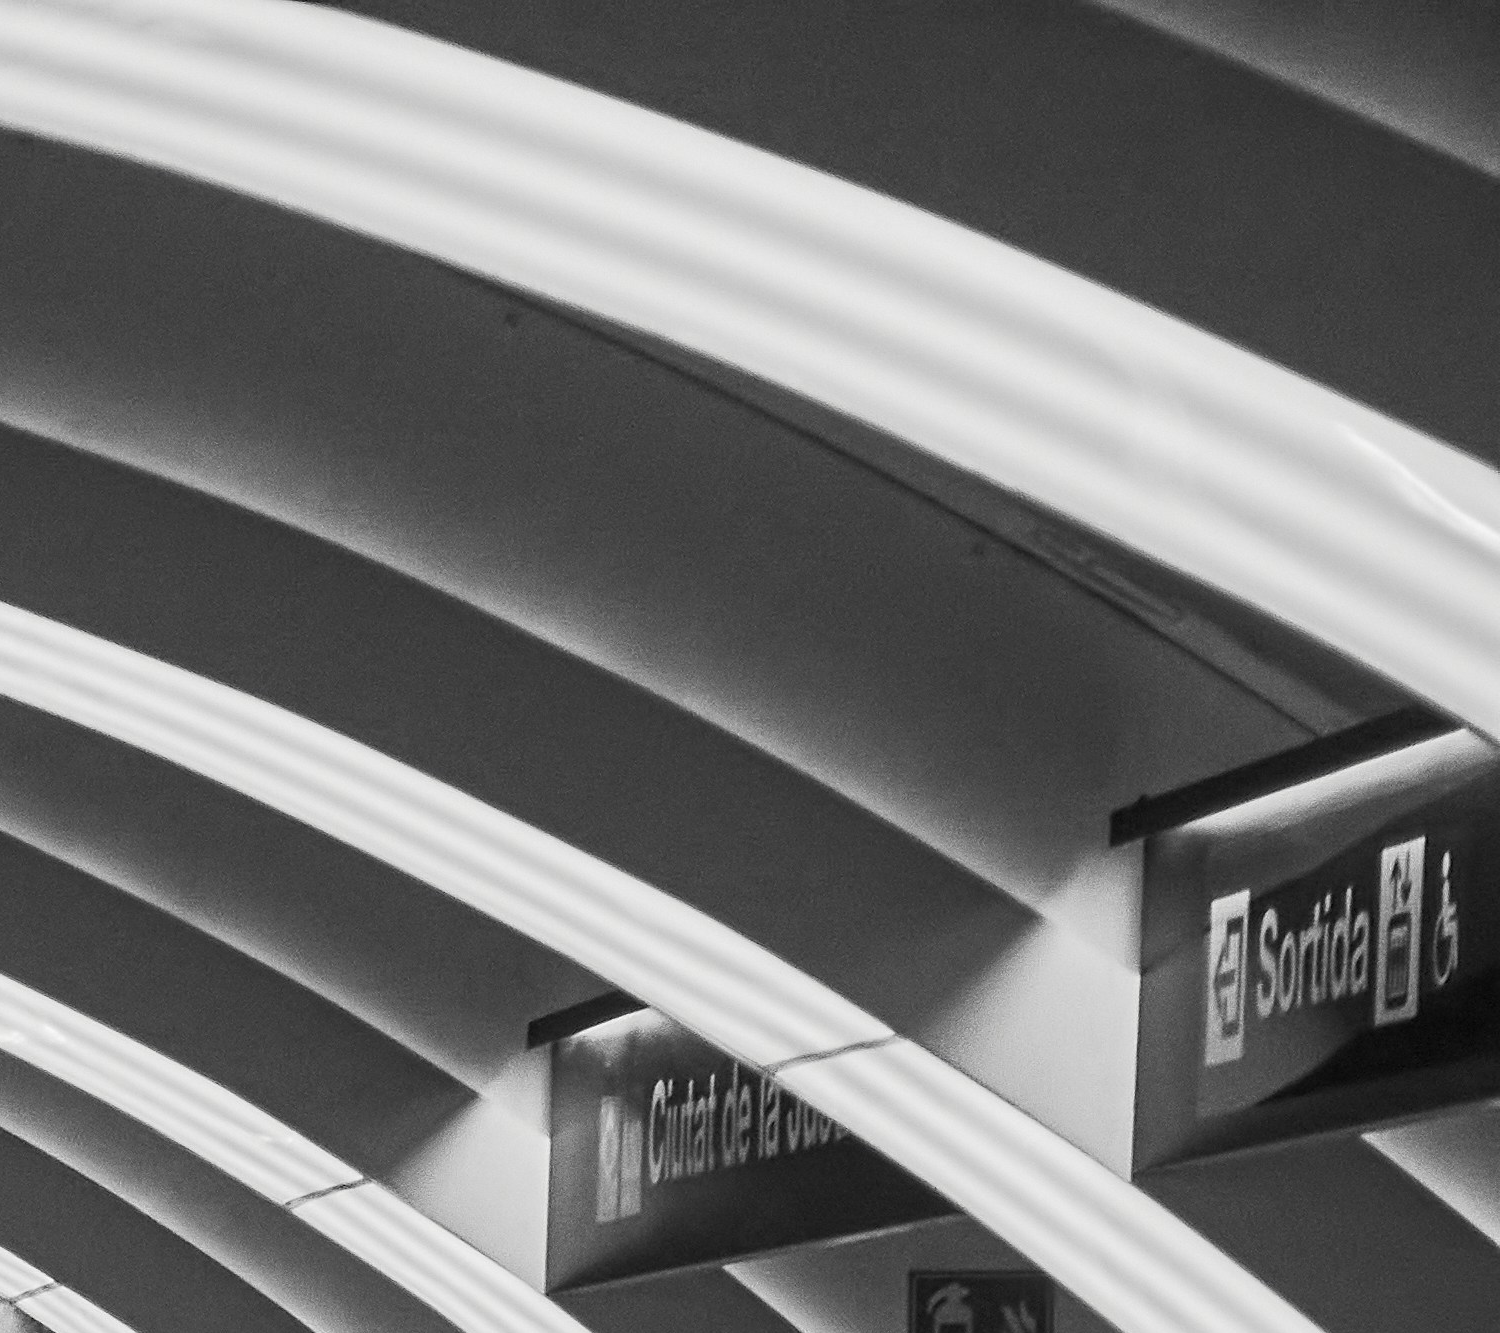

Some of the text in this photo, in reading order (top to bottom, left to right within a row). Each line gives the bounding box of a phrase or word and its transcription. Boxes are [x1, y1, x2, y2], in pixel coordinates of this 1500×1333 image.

[1256, 885, 1370, 1020] Sortida
[648, 1072, 717, 1184] Ciutat
[721, 1061, 753, 1167] de
[757, 1073, 781, 1160] la
